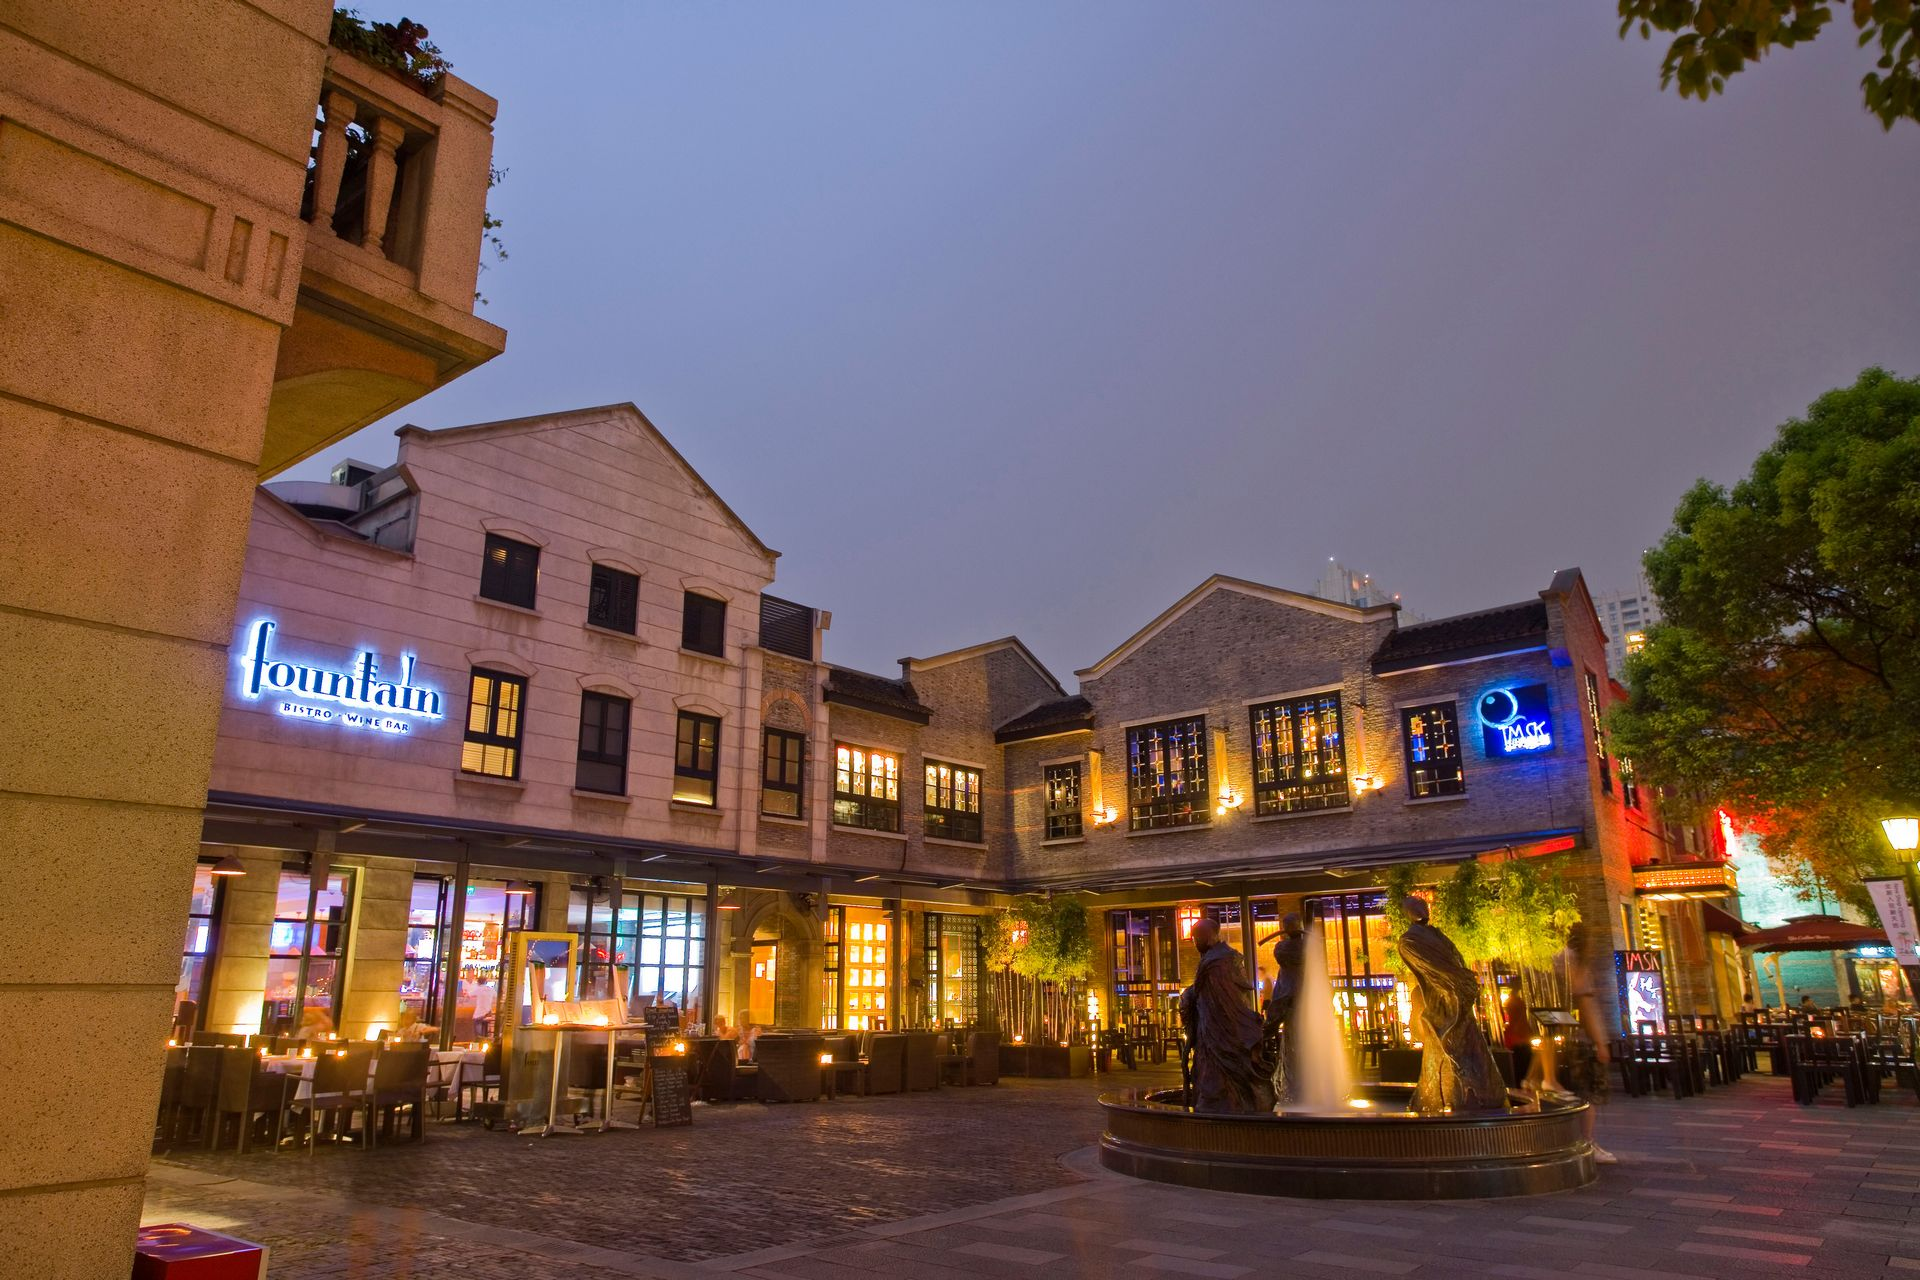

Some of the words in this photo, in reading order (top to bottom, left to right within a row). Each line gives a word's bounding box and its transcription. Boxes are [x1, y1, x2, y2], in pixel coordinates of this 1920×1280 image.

[246, 619, 443, 716] fountain
[282, 702, 333, 719] BISTRO
[346, 712, 381, 728] WINE
[386, 720, 410, 733] BAR
